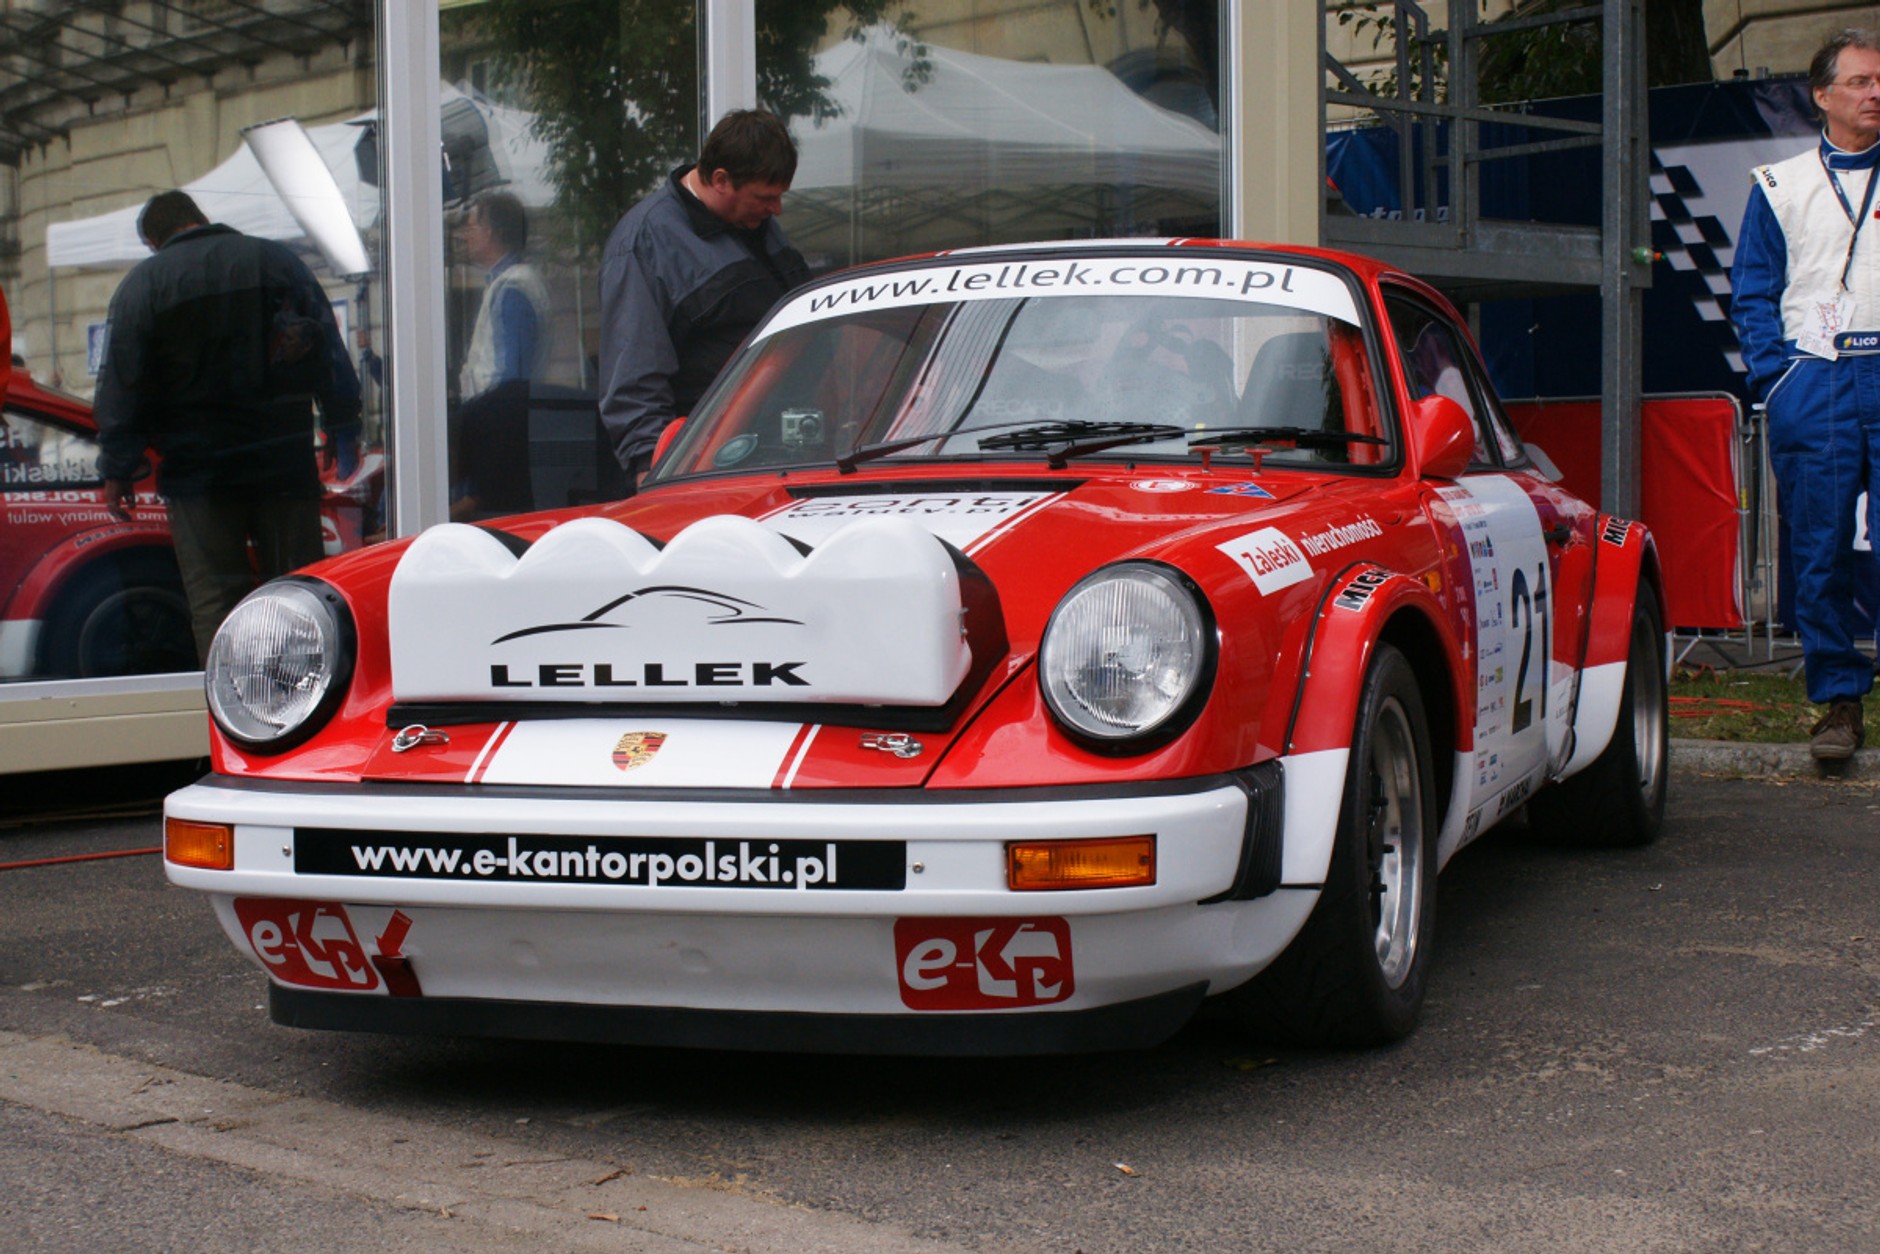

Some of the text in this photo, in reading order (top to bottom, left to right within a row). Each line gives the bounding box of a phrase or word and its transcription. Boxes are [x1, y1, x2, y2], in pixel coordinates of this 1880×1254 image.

[1763, 170, 1778, 188] LICO
[810, 262, 1295, 314] www.lellek.com.pl
[1852, 335, 1878, 347] LICO
[791, 495, 1038, 512] conti
[1241, 539, 1301, 576] Zaleski
[1512, 562, 1548, 735] 21
[491, 662, 812, 687] LELLEK
[351, 837, 837, 890] www.e-kantorpolski.pl
